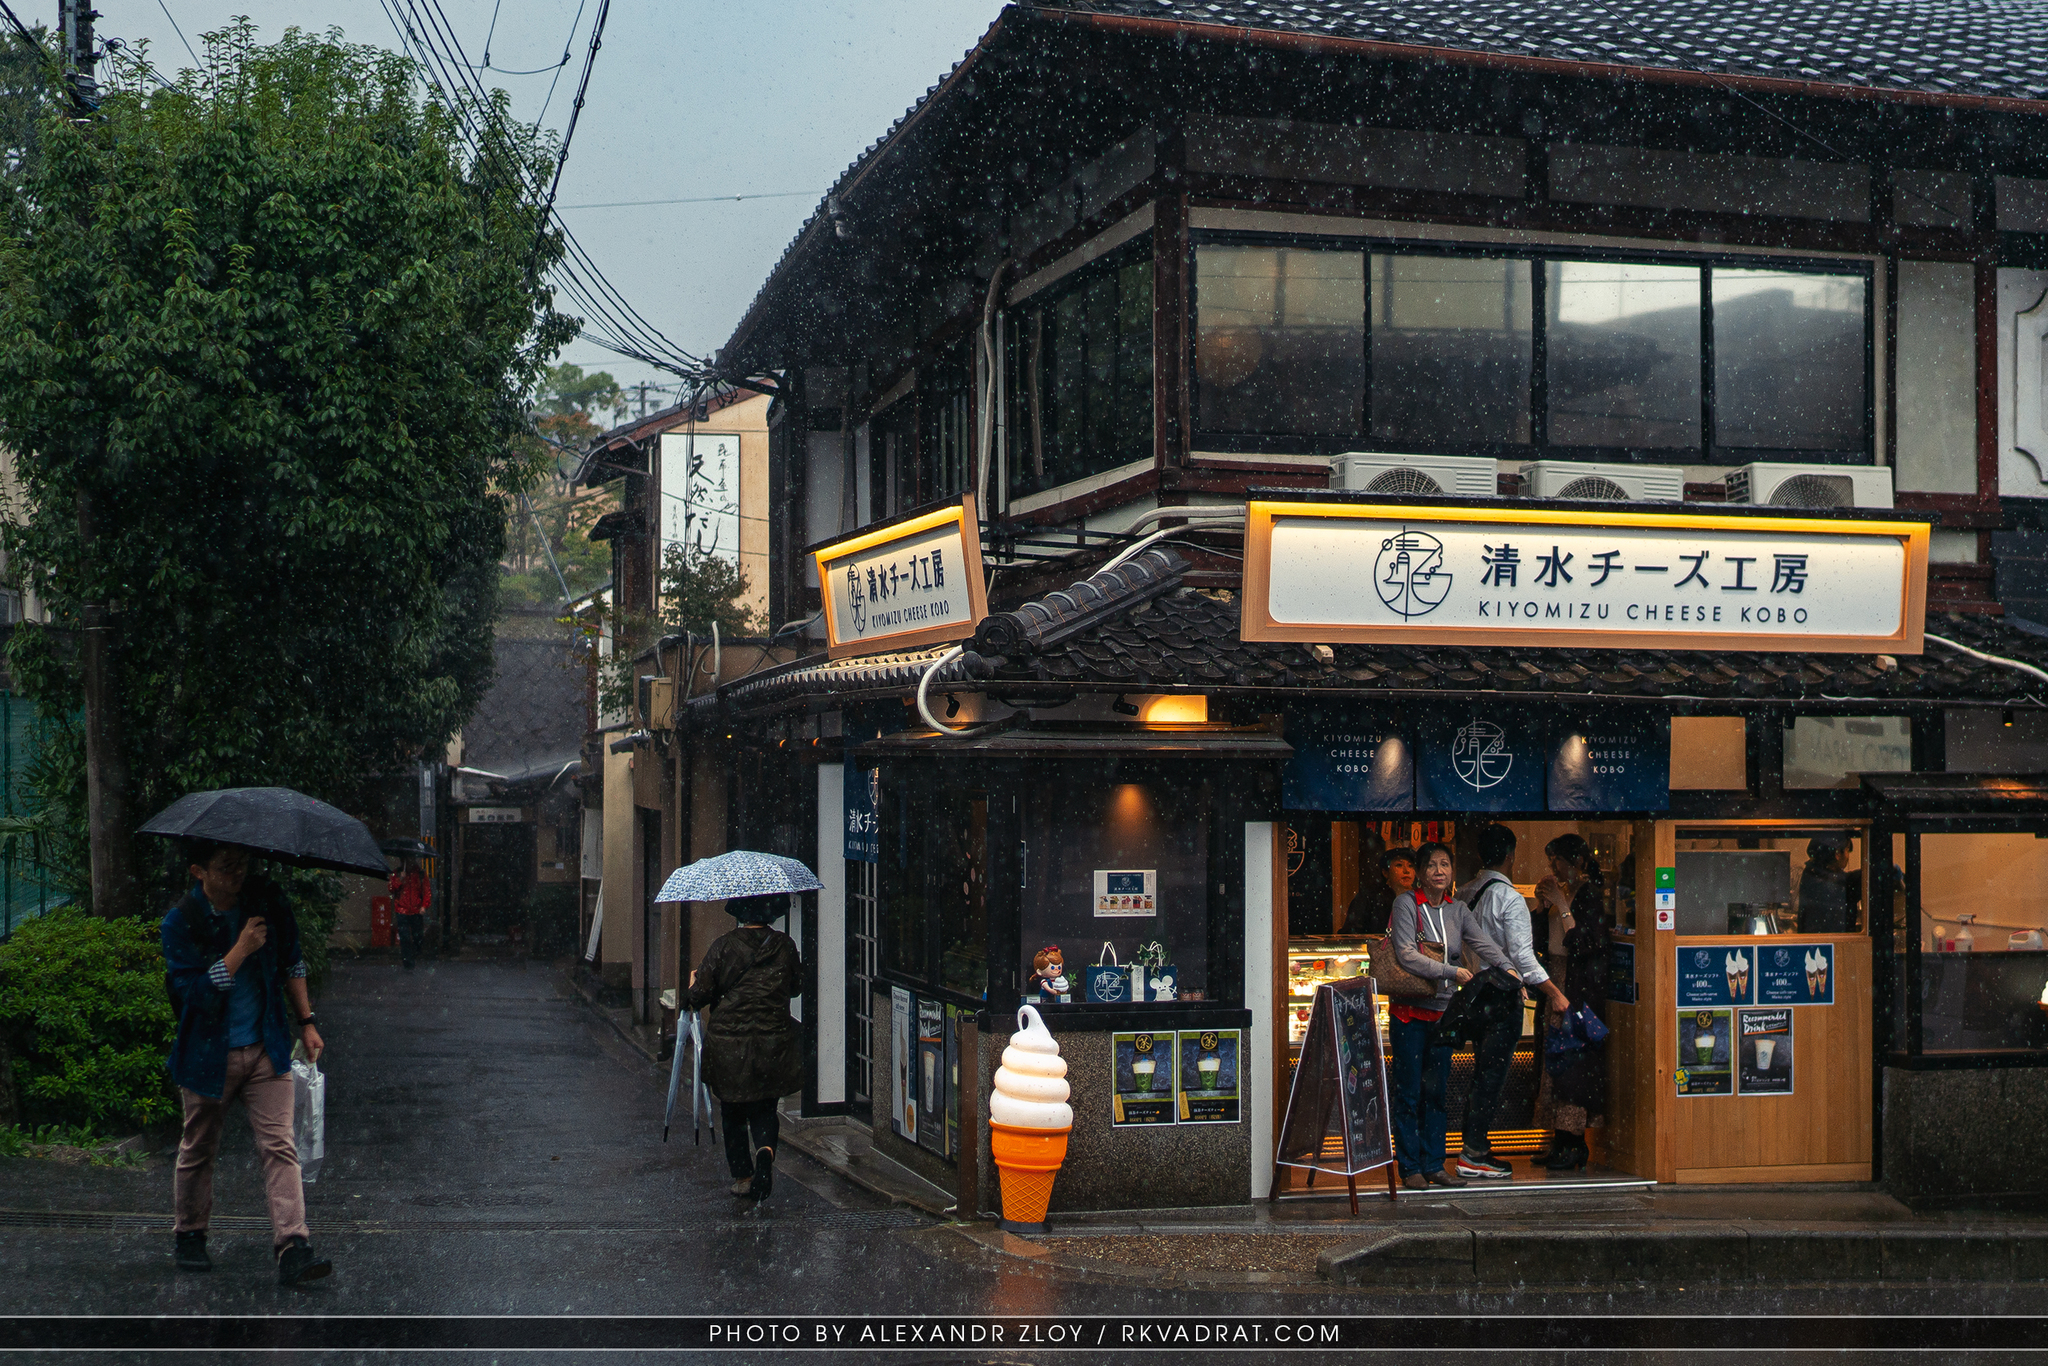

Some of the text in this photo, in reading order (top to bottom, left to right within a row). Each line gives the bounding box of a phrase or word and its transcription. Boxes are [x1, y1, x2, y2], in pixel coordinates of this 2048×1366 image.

[1479, 543, 1809, 594] 清水チーズ工房
[865, 548, 945, 603] 清水チーズ工房
[871, 599, 950, 629] KIYOMIZU CHEESE KOBO
[1478, 600, 1809, 624] KIYOMIZU CHEESE KOBO
[1323, 734, 1382, 743] KIYOMIZU
[1581, 735, 1638, 745] KIYOMIZU
[1330, 749, 1375, 758] CHEESE
[1588, 750, 1630, 759] CHEESE
[1336, 764, 1369, 773] KOBO
[1593, 765, 1625, 774] KOBO
[1743, 1010, 1787, 1023] Recommended
[1743, 1021, 1766, 1034] Drink
